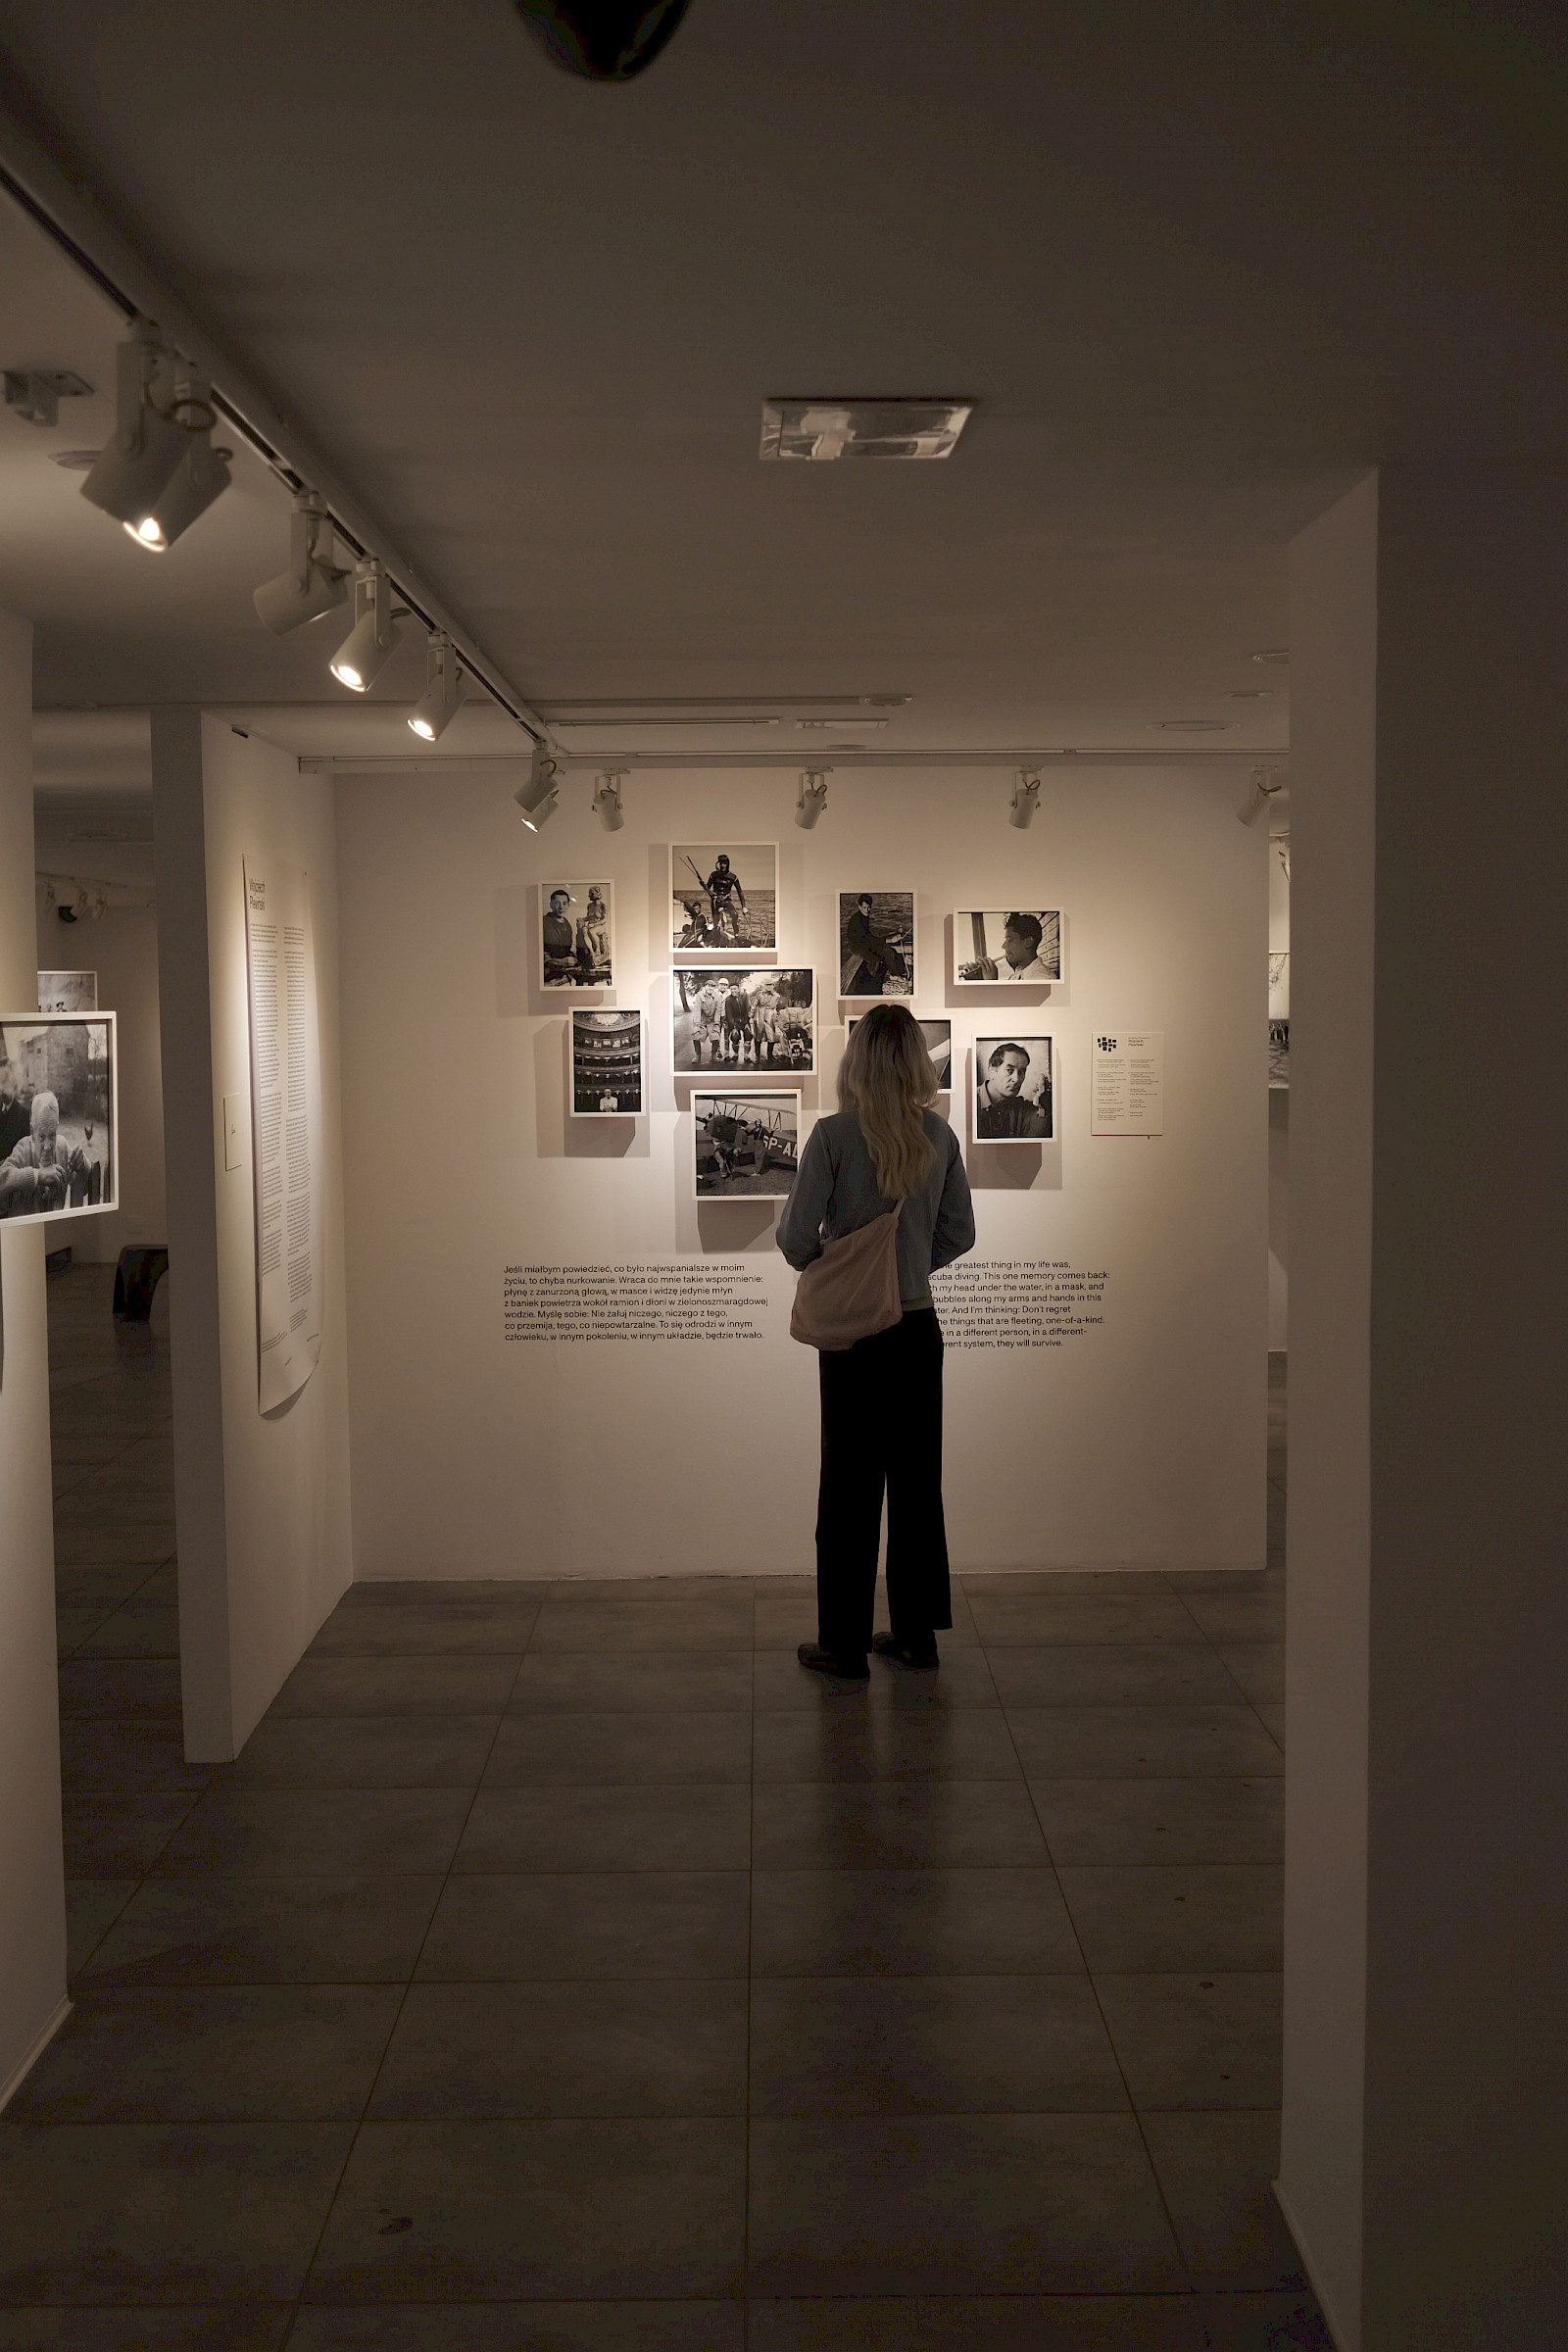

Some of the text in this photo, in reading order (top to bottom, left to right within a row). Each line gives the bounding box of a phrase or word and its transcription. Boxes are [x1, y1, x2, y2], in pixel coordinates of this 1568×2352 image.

[524, 1265, 561, 1274] miałbym
[563, 1264, 612, 1274] powiedzieć,
[627, 1264, 644, 1274] było
[646, 1264, 710, 1273] najwspanialsze
[954, 1260, 989, 1270] greatest
[991, 1260, 1012, 1270] thing
[1014, 1260, 1021, 1268] in
[1024, 1262, 1036, 1270] my
[1038, 1259, 1050, 1268] life
[504, 1276, 527, 1286] życiu,
[539, 1276, 564, 1286] chyba
[705, 1275, 763, 1284] wspomnienie:
[954, 1271, 981, 1282] diving.
[983, 1271, 1000, 1280] This
[1020, 1273, 1055, 1281] memory
[1087, 1270, 1110, 1279] back:
[654, 1286, 678, 1296] widzę
[679, 1286, 710, 1296] jedynie
[939, 1285, 952, 1294] my
[954, 1283, 975, 1291] head
[977, 1283, 1001, 1291] under
[1003, 1282, 1017, 1291] the
[1019, 1282, 1044, 1292] water,
[1045, 1282, 1053, 1290] in
[1062, 1282, 1086, 1292] mask,
[1088, 1281, 1104, 1290] and
[540, 1298, 581, 1308] powietrza
[968, 1294, 991, 1304] along
[994, 1296, 1006, 1304] my
[1032, 1293, 1047, 1302] and
[1049, 1293, 1075, 1301] hands
[1077, 1293, 1084, 1301] in
[1086, 1293, 1102, 1301] this
[537, 1310, 562, 1319] Myślę
[607, 1309, 627, 1319] żałuj
[629, 1309, 664, 1318] niczego,
[666, 1309, 698, 1318] niczego
[707, 1308, 728, 1318] tego,
[951, 1305, 968, 1314] And
[985, 1305, 1020, 1315] thinking:
[1046, 1304, 1071, 1315] regret
[517, 1321, 555, 1331] przemija,
[557, 1321, 578, 1330] tego,
[592, 1320, 657, 1330] niepowtarzalne.
[671, 1320, 683, 1329] się
[727, 1320, 752, 1329] innym
[950, 1317, 975, 1327] things
[977, 1316, 993, 1325] that
[1011, 1316, 1044, 1326] fleeting,
[1046, 1315, 1105, 1324] one-of-a-kind.
[505, 1333, 548, 1342] człowieku,
[559, 1332, 584, 1342] innym
[586, 1332, 629, 1342] pokoleniu,
[639, 1332, 665, 1341] innym
[667, 1331, 704, 1341] układzie,
[706, 1331, 733, 1341] będzie
[946, 1328, 954, 1336] in
[963, 1327, 998, 1336] different
[999, 1329, 1031, 1337] person,
[1032, 1327, 1040, 1335] in
[1049, 1326, 1087, 1335] different-
[963, 1338, 995, 1349] system,
[997, 1338, 1014, 1349] they
[1017, 1338, 1030, 1346] will
[1032, 1338, 1063, 1346] survive.
